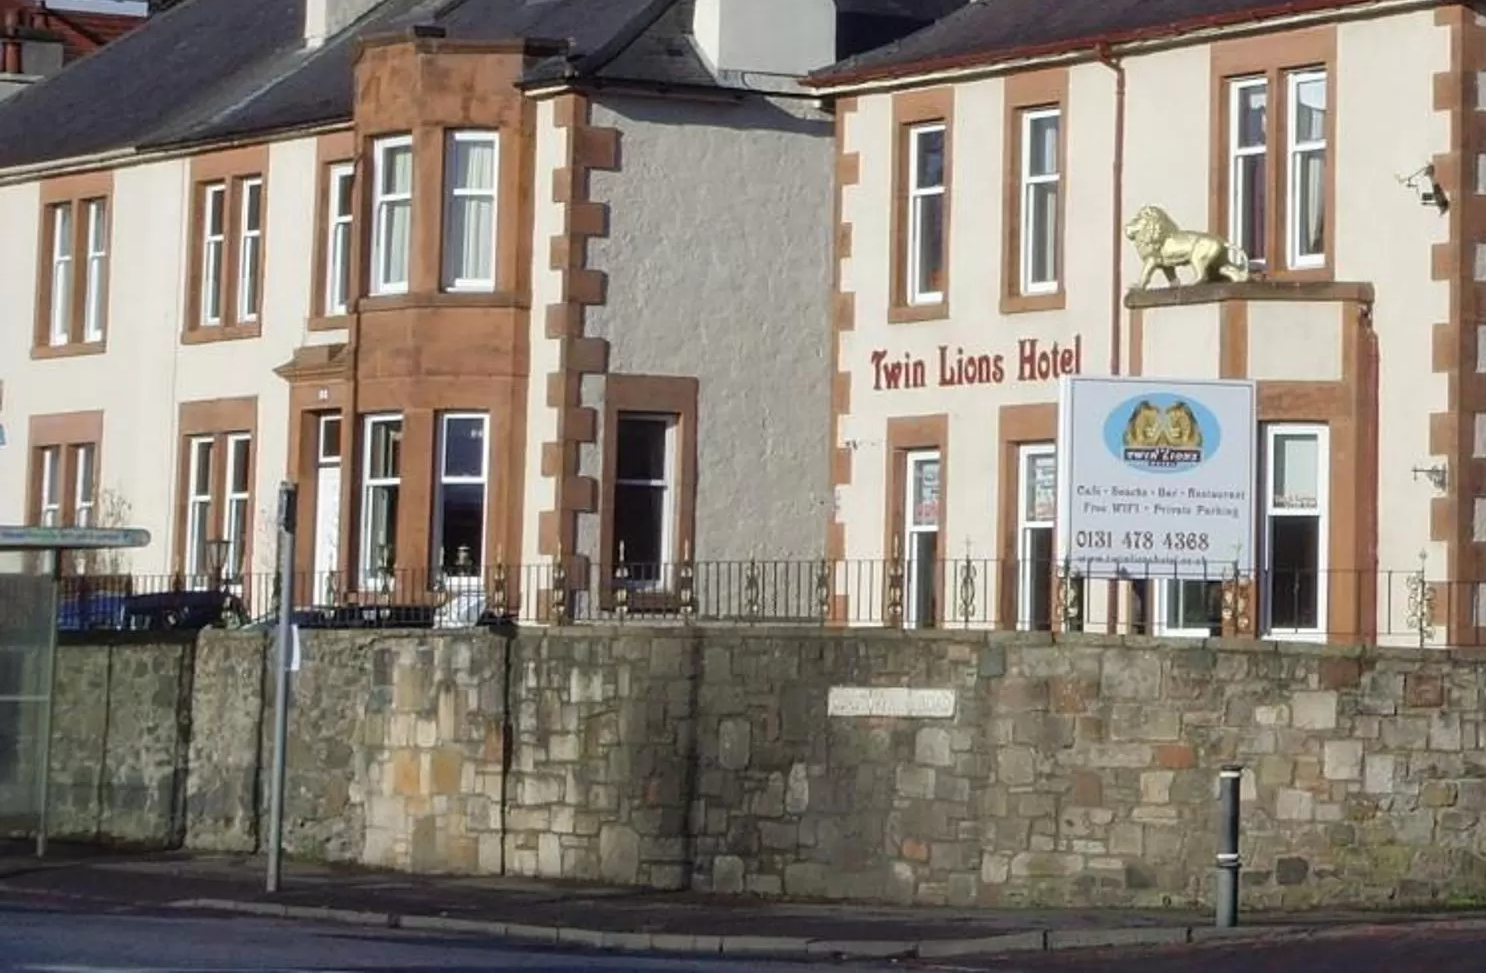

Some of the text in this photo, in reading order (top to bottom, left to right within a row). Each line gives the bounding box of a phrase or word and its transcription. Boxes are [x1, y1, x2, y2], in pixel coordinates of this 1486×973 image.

[871, 334, 1082, 390] Twin Lions Hotel
[1196, 505, 1239, 518] Parking
[1076, 530, 1210, 551] 0131 478 4368
